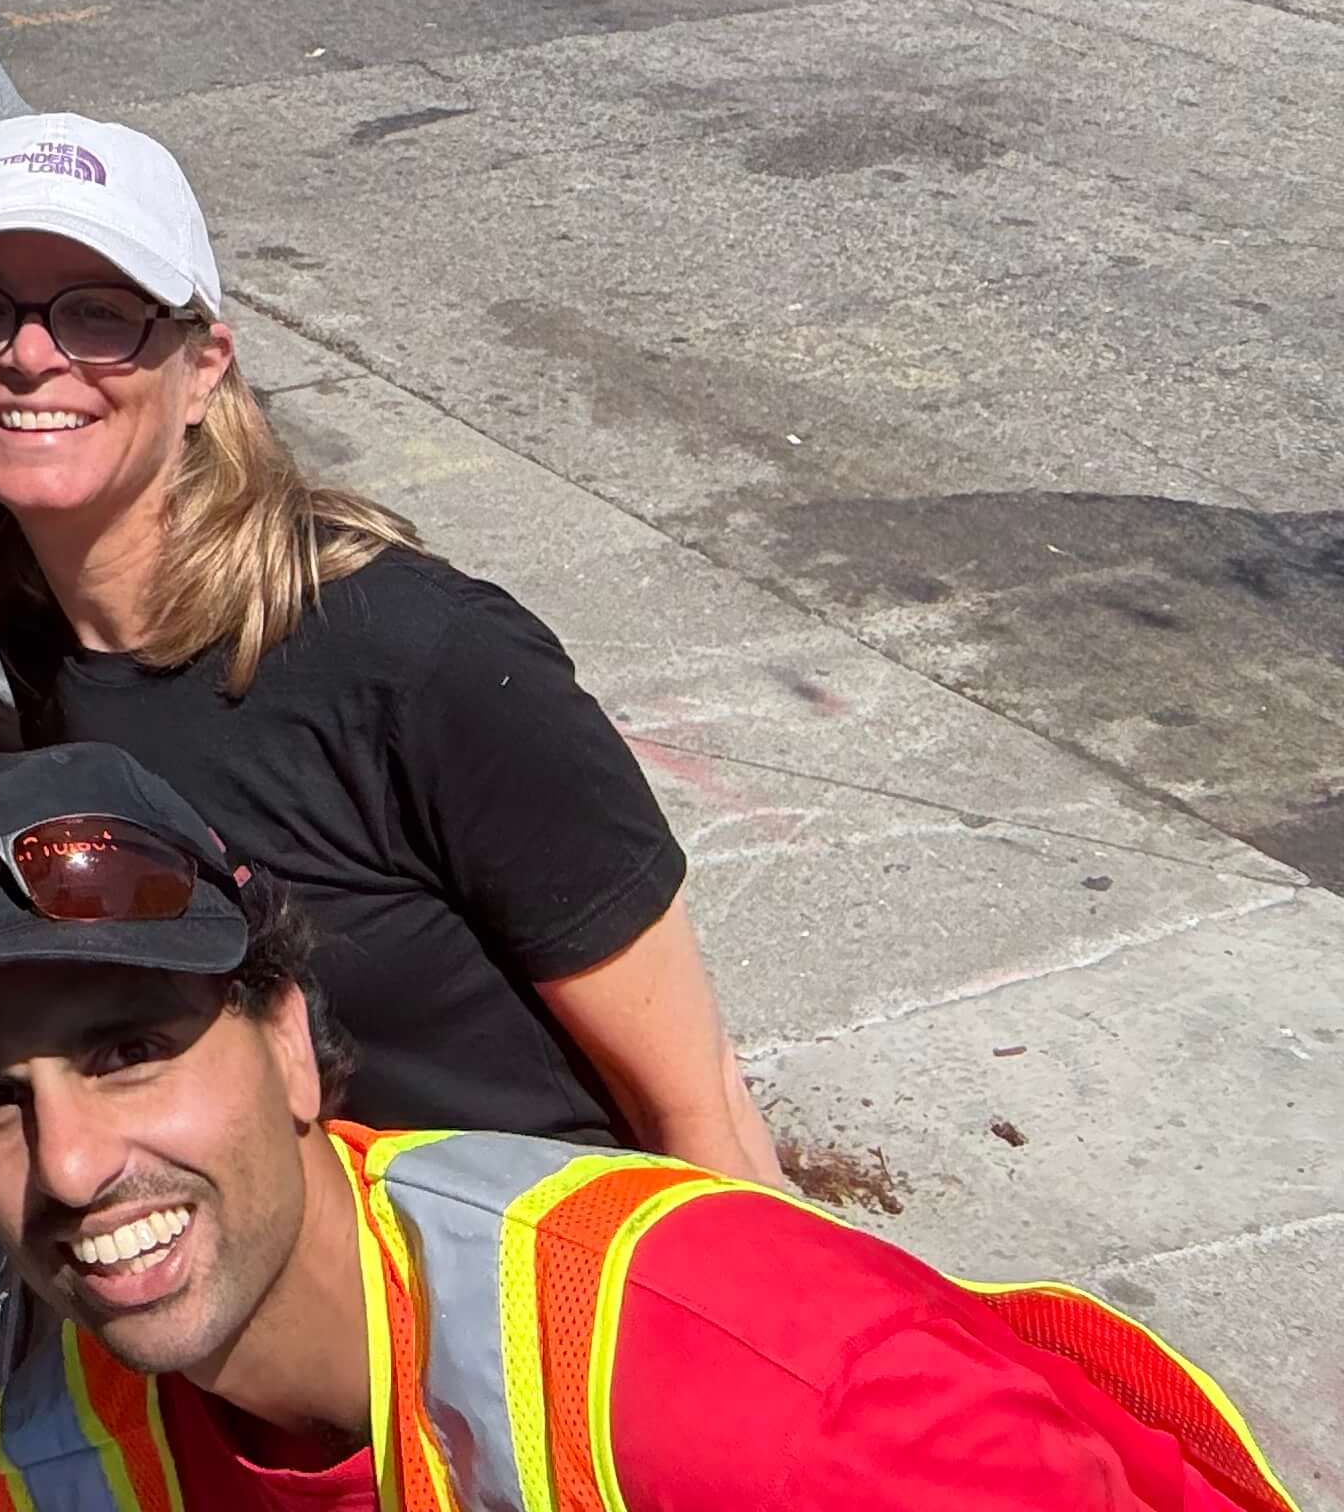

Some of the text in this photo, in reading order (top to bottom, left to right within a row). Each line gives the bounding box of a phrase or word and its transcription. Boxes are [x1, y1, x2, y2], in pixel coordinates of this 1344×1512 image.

[36, 142, 73, 155] THE
[0, 152, 72, 166] TENDER
[28, 162, 72, 176] LOIN
